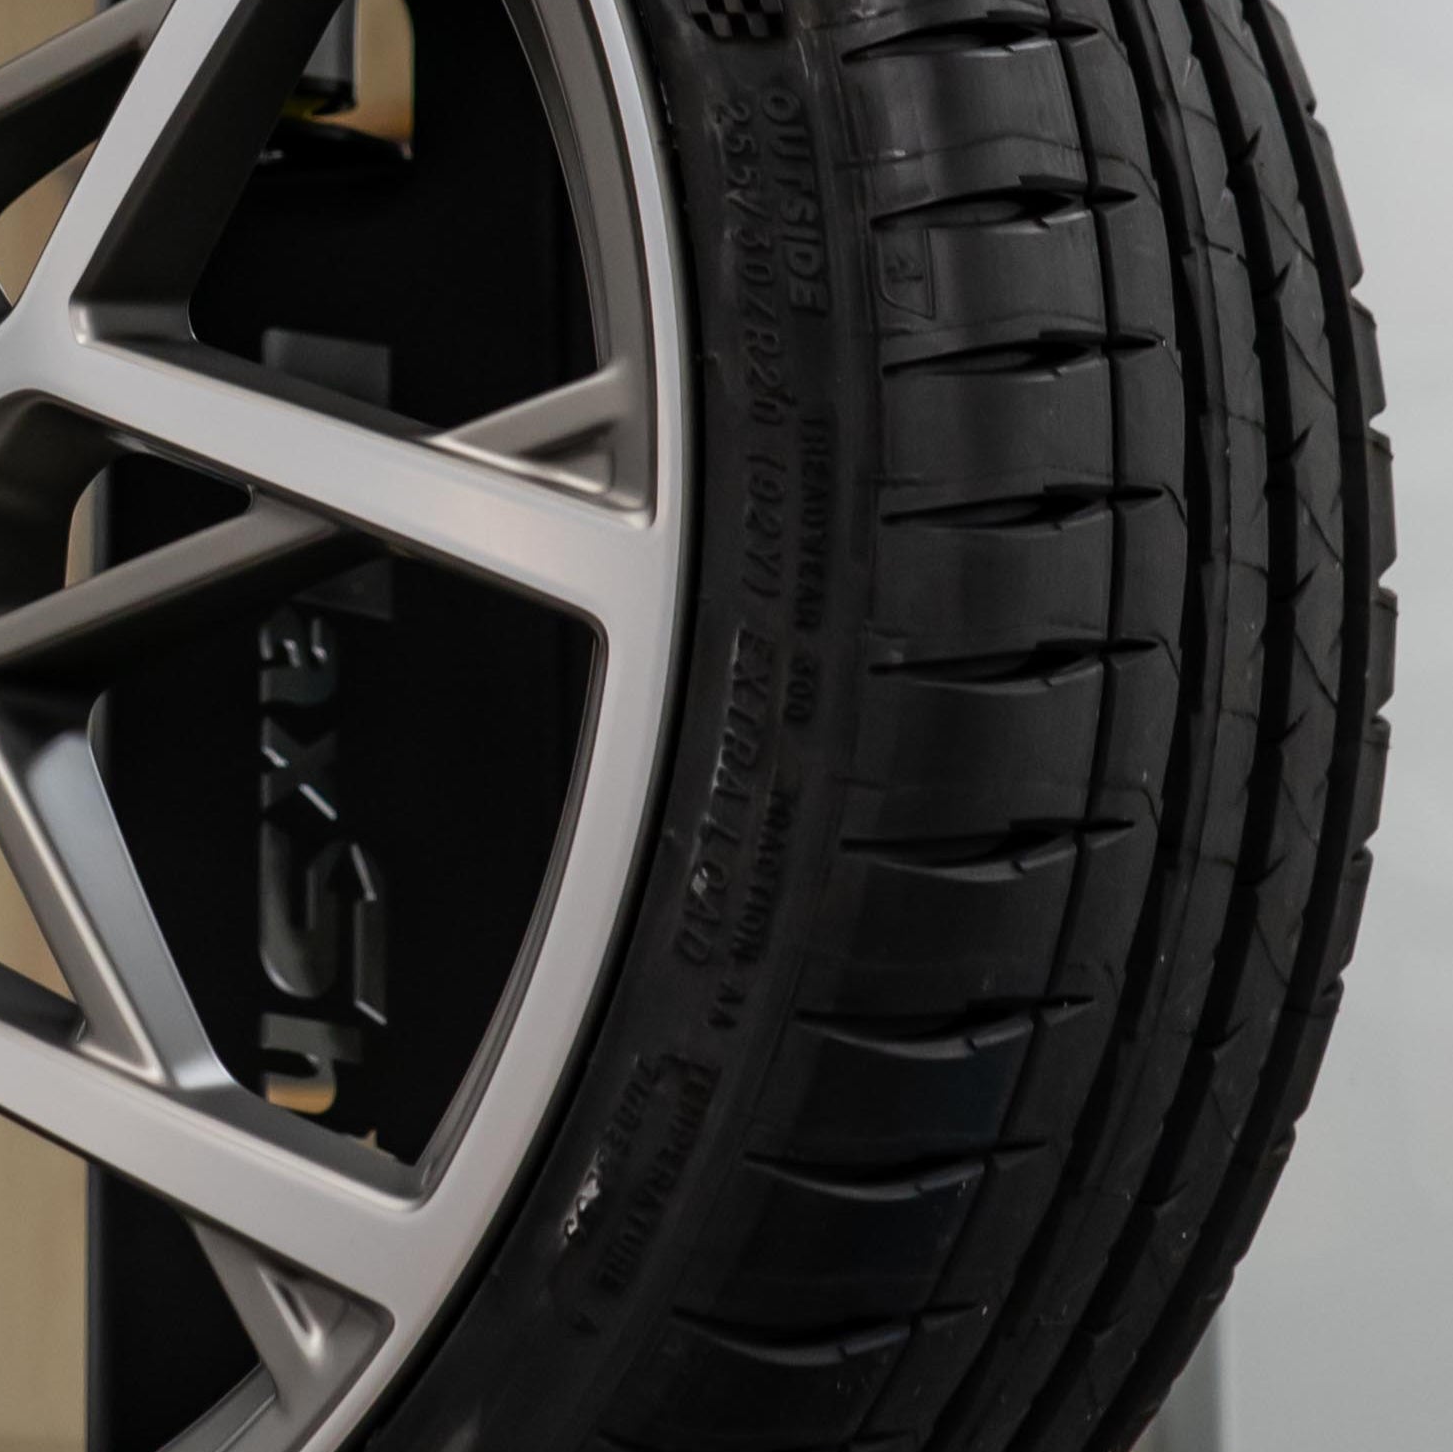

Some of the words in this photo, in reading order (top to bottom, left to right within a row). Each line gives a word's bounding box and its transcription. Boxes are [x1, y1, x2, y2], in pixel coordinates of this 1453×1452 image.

[759, 86, 831, 319] OUTSIDE
[794, 413, 836, 631] TREADWEAR
[714, 628, 776, 804] EXTRA
[730, 789, 802, 966] TRACTION
[594, 1066, 722, 1300] TEMPERATURE
